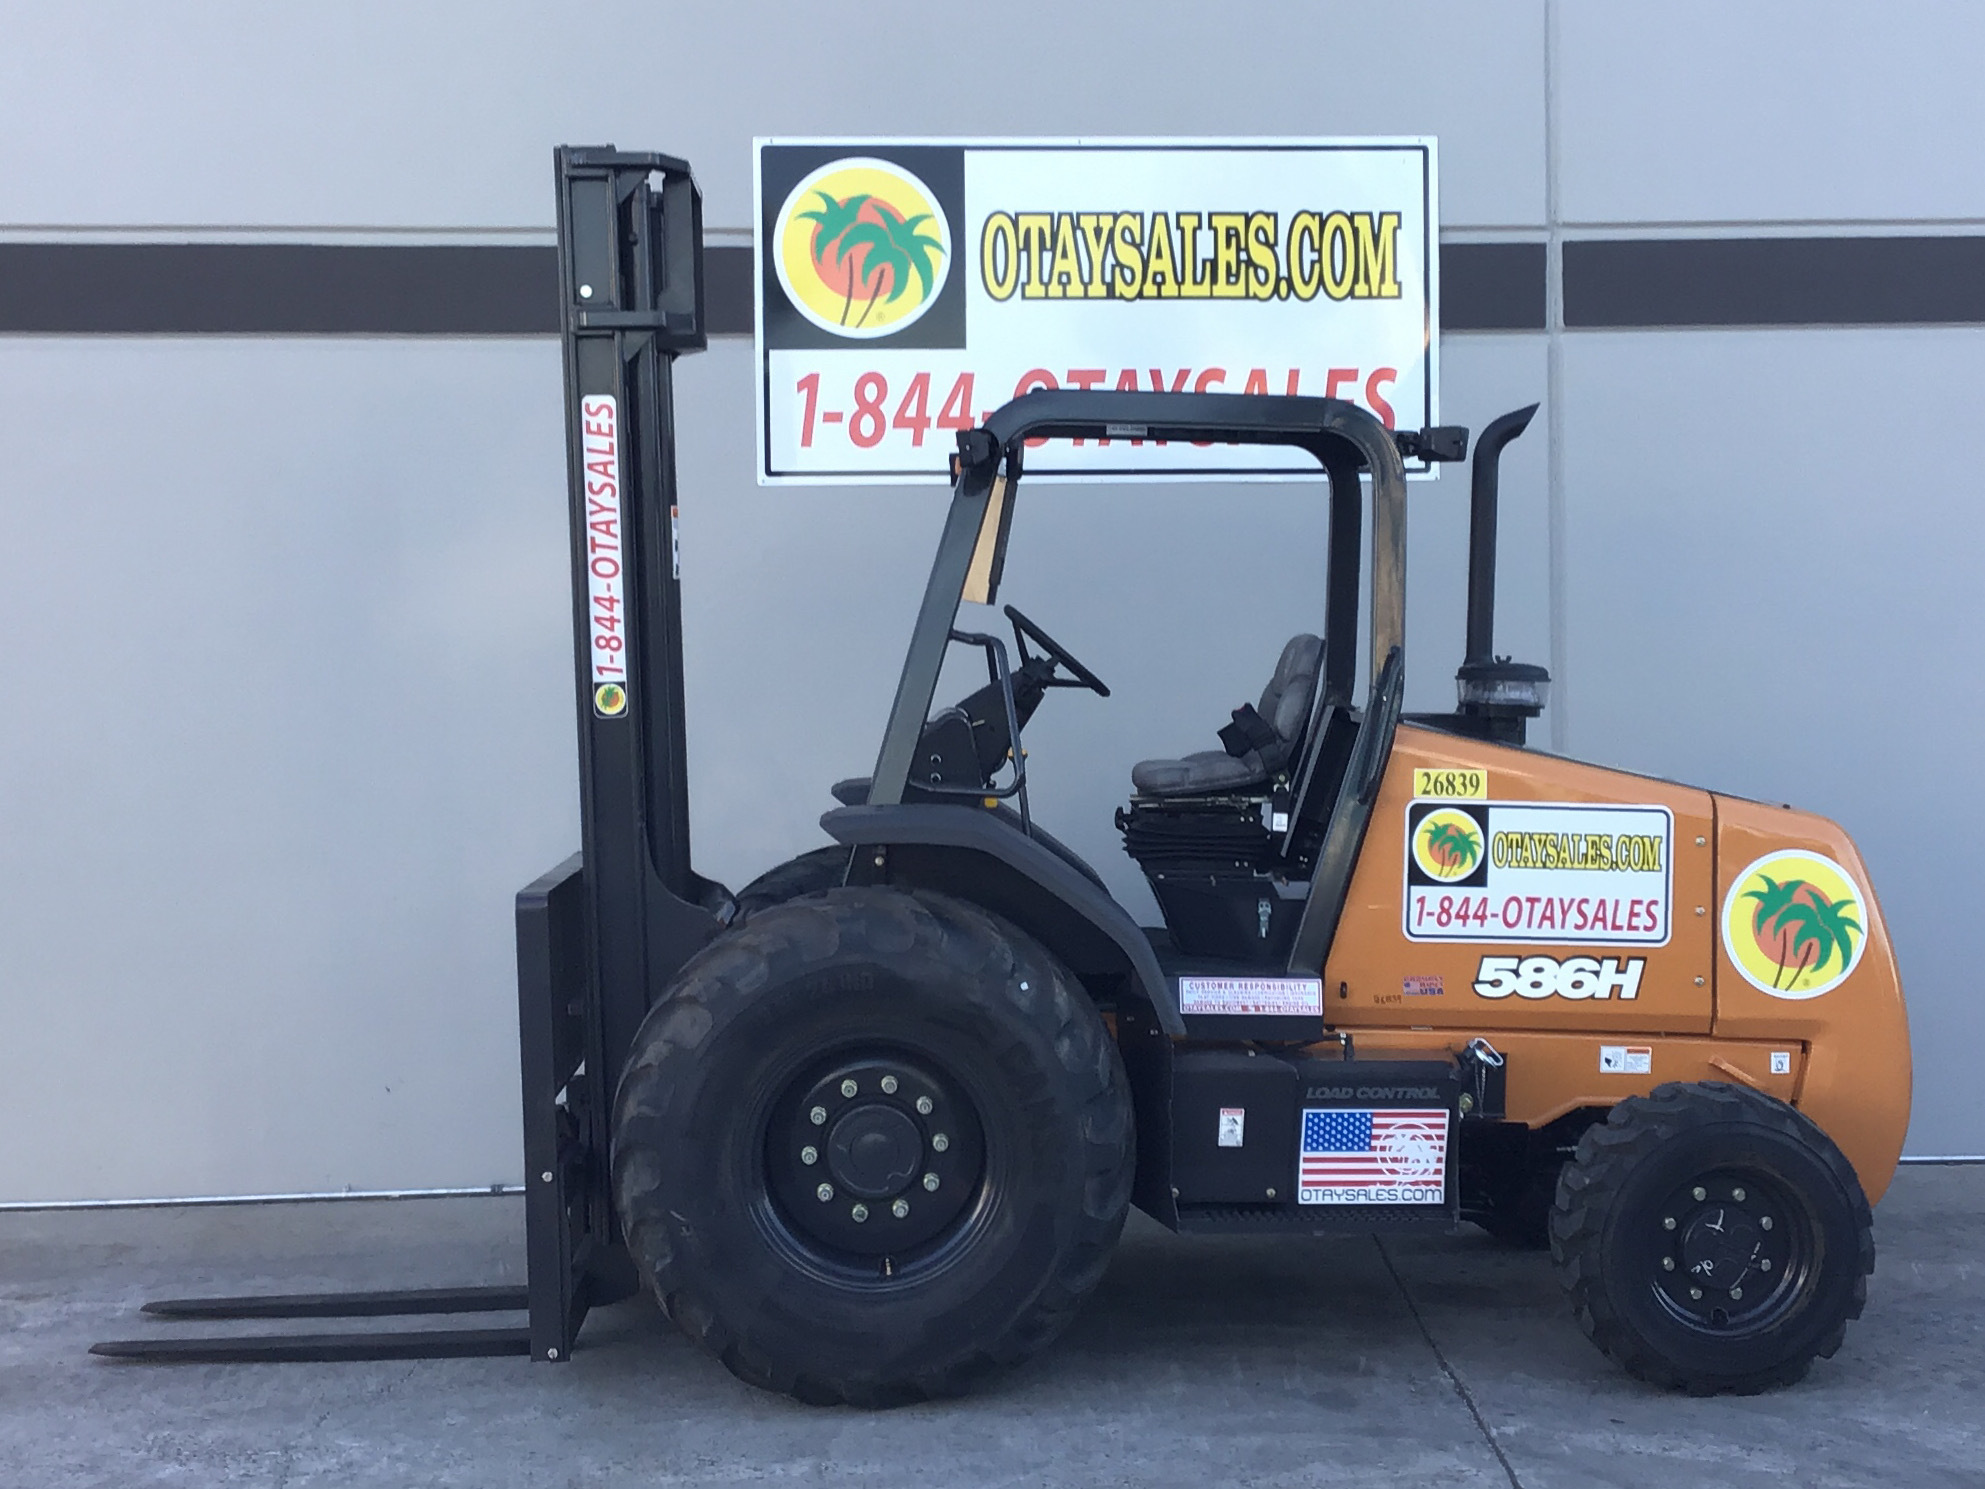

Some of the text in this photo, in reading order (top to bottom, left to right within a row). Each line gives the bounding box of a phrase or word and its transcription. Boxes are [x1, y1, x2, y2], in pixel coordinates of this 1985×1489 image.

[981, 210, 1402, 301] OTAYSALES.COM
[585, 403, 623, 676] 1-844-OTAYSALES
[1421, 771, 1480, 797] 26839
[1492, 831, 1663, 872] OTAYSALES.COM
[1415, 895, 1660, 933] 1-844-OTAYSALES
[1189, 982, 1307, 991] CUSTOMER RESPONSIBILITY
[1473, 954, 1647, 1000] 586H
[1306, 1087, 1440, 1100] LOAD CONTROL
